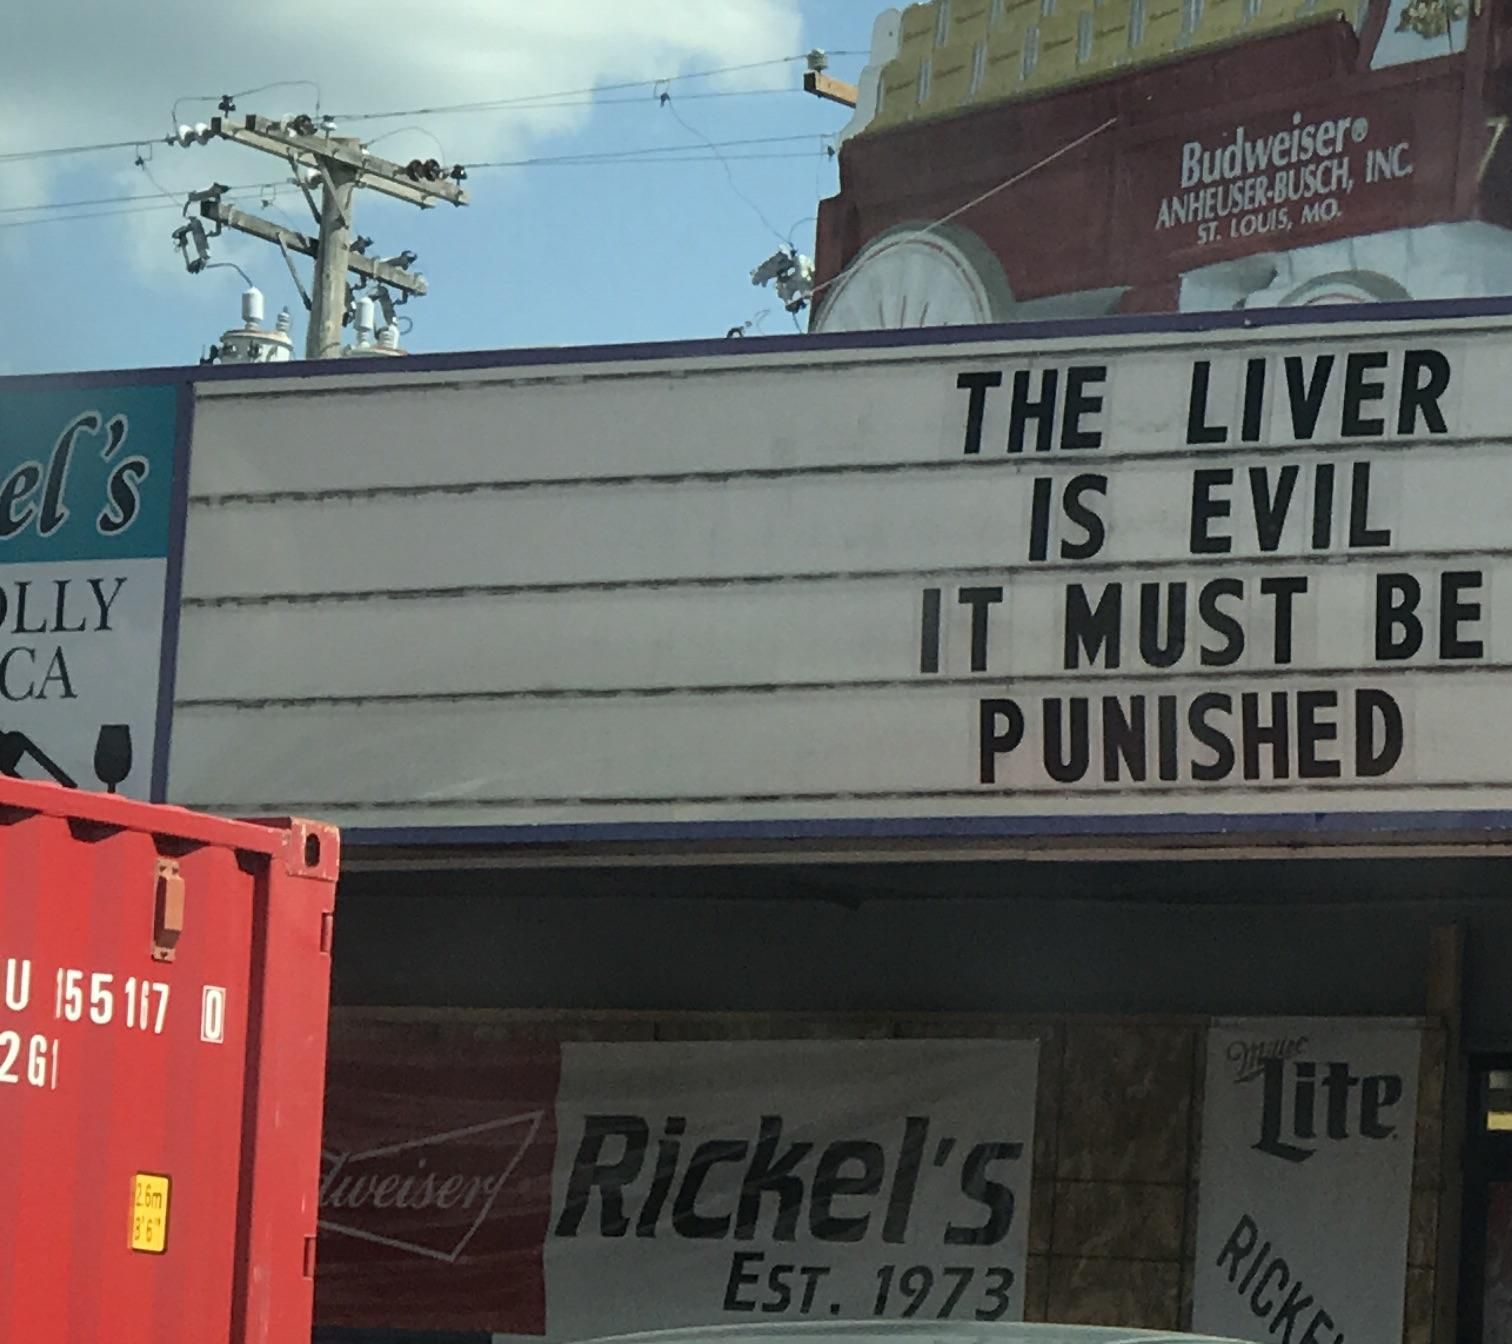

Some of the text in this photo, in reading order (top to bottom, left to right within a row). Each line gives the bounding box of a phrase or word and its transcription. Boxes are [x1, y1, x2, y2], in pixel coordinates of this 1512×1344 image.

[1154, 158, 1355, 231] ANHEUSER-BUSCH,
[1197, 219, 1222, 245] ST.
[1301, 197, 1343, 225] MO.
[956, 350, 1451, 455] THE LIVER
[1028, 461, 1392, 562] IS EVIL
[920, 570, 1484, 674] IT MUST BE
[980, 688, 1404, 784] PUNISHED
[1250, 1055, 1402, 1163] Lite
[554, 1113, 1022, 1247] Rickel's
[873, 1265, 1014, 1322] 1973
